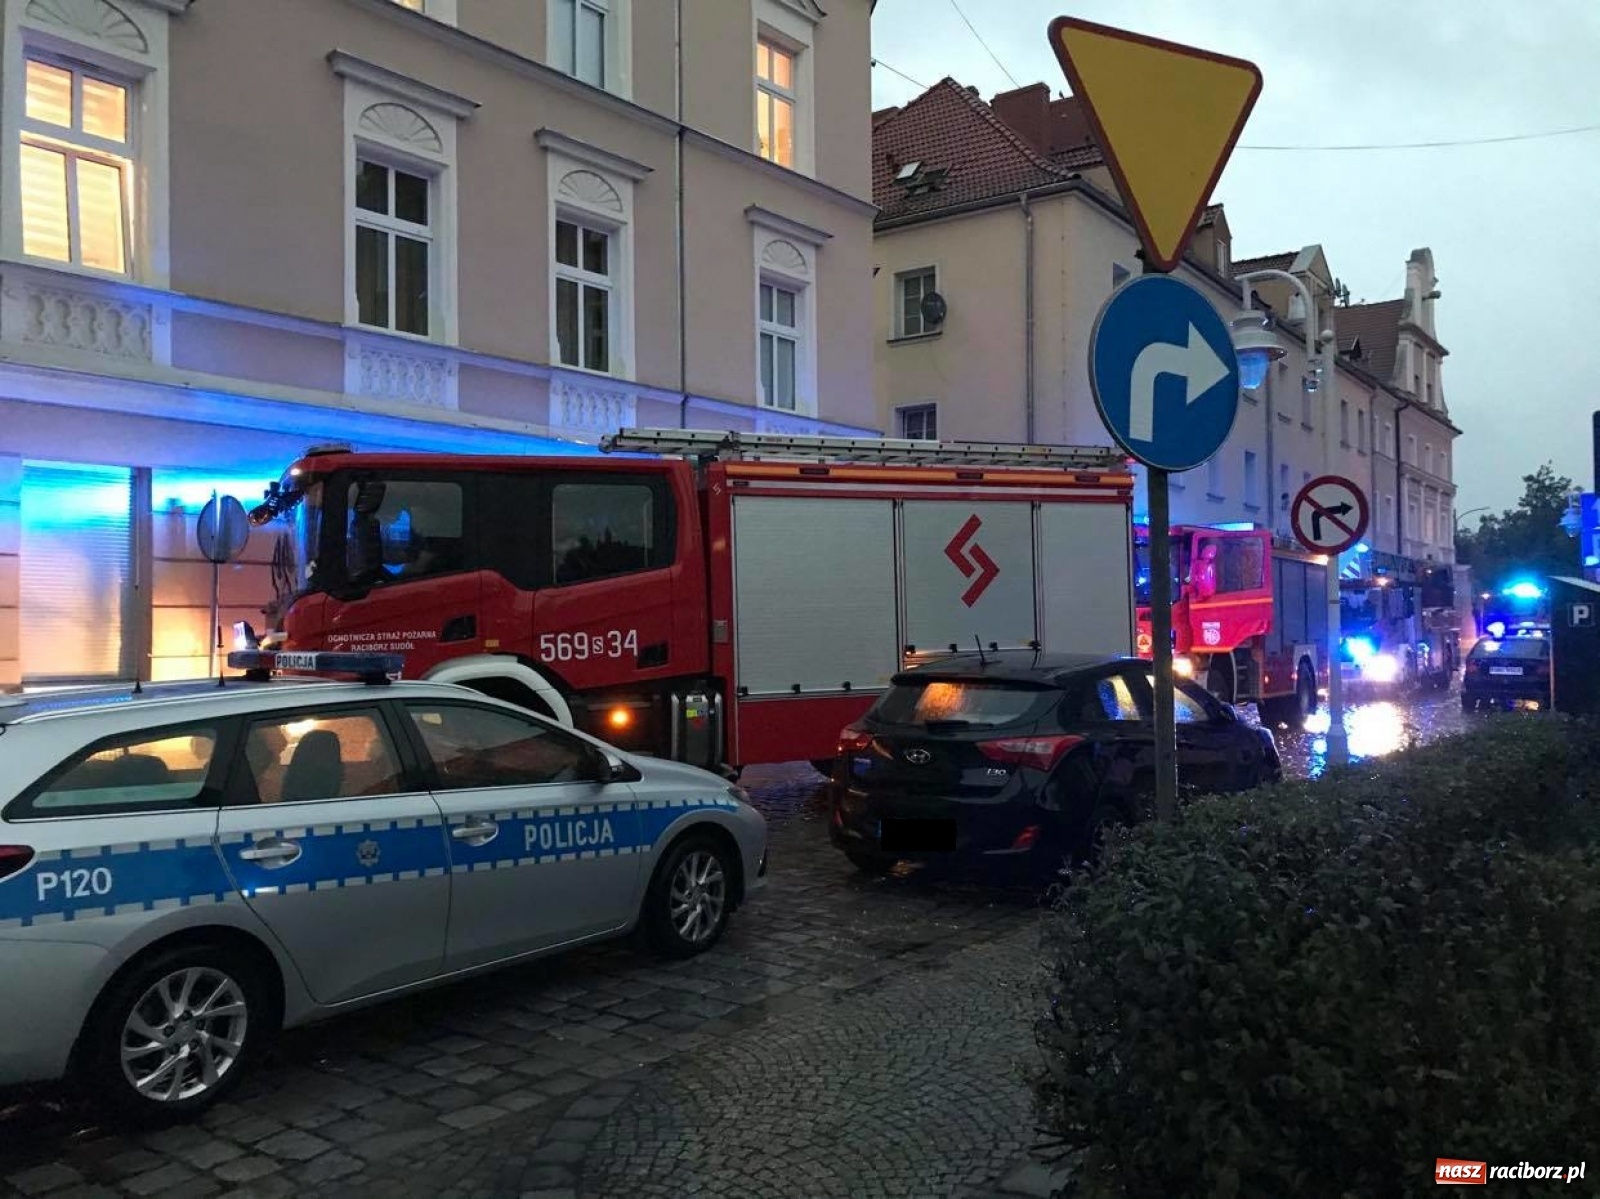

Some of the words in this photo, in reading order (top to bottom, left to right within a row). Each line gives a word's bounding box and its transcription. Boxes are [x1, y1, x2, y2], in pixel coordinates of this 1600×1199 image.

[1573, 605, 1589, 625] P
[277, 654, 314, 668] POLICJA
[524, 818, 614, 851] POLICJA
[37, 867, 112, 901] P120
